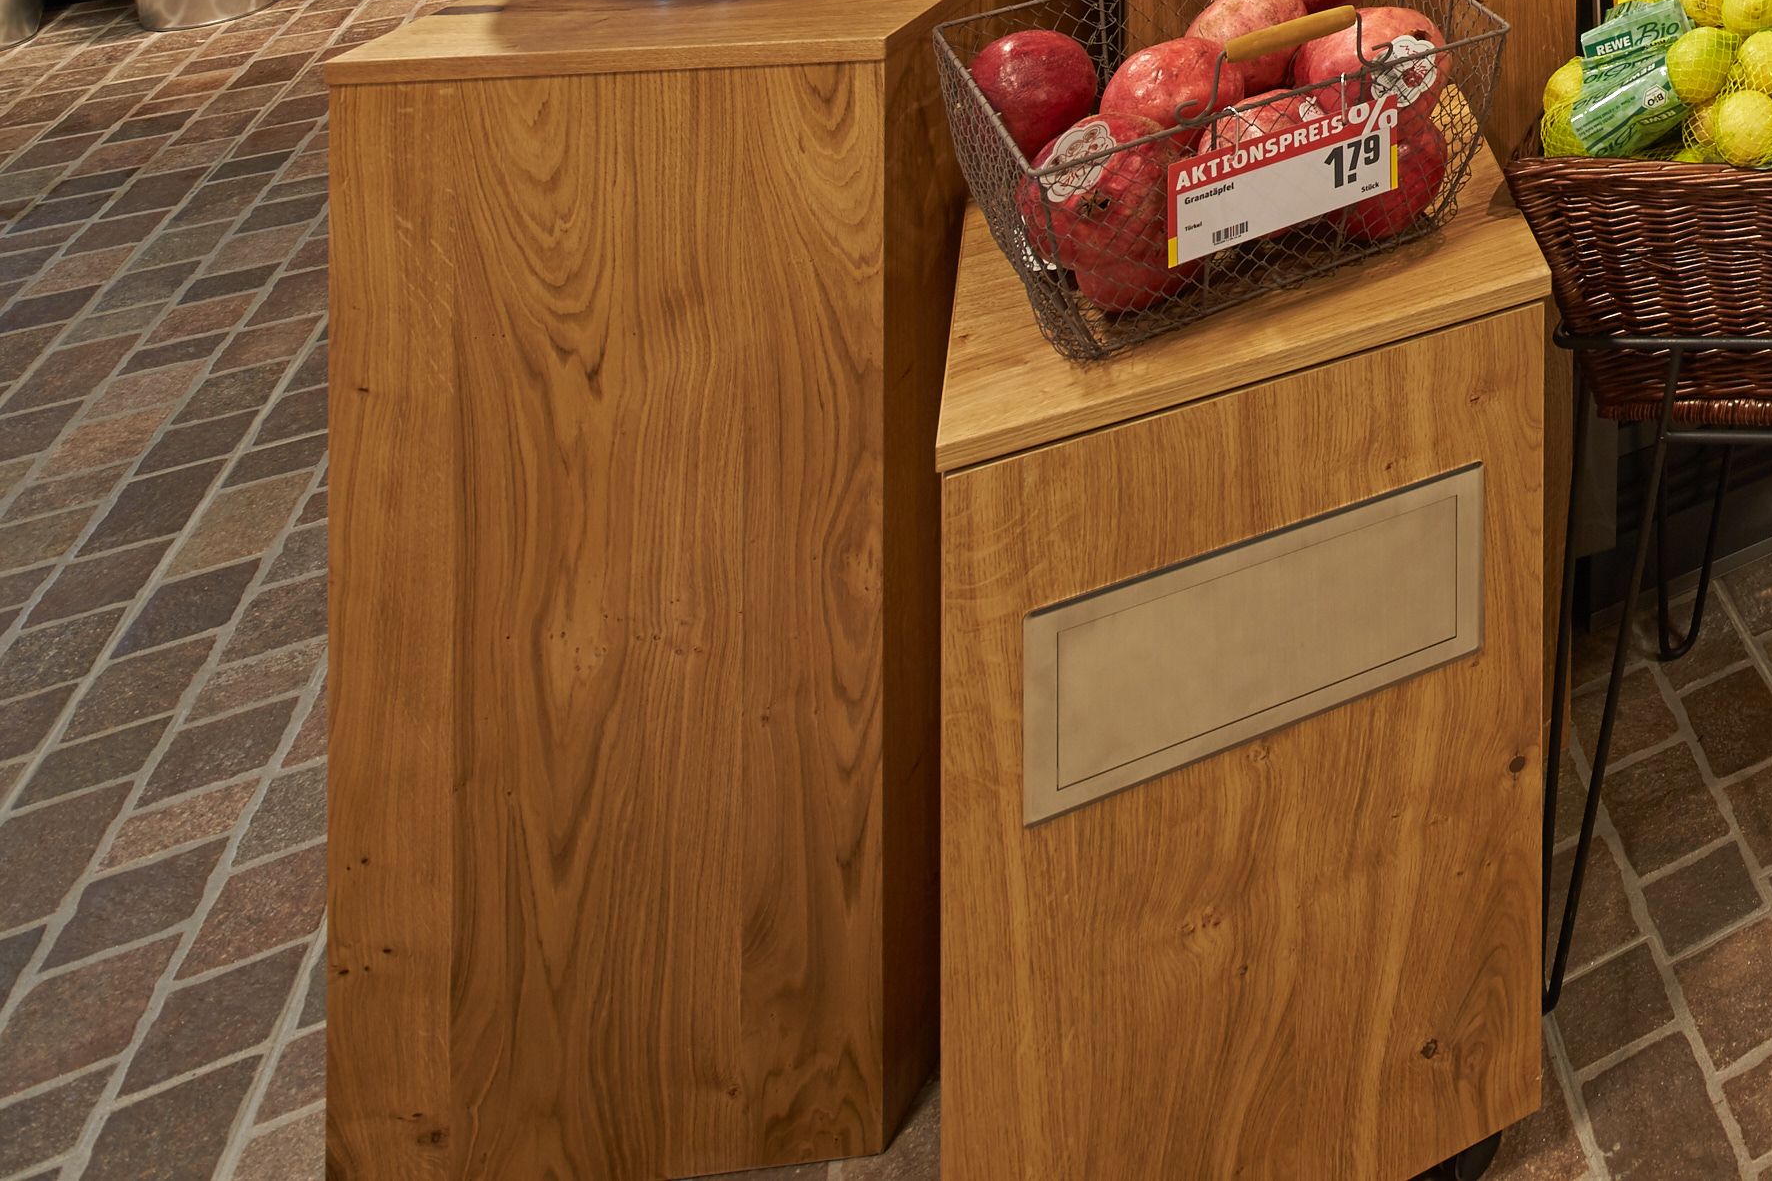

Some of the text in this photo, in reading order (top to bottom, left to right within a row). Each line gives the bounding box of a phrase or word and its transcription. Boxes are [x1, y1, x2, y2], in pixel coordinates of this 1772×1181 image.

[1596, 21, 1680, 56] REWE Bio
[1175, 114, 1344, 191] AKTIONSPREIS
[1324, 134, 1381, 189] 1.79
[1184, 182, 1235, 205] Granatäpfel
[1361, 181, 1380, 194] Stück
[1184, 221, 1203, 232] Türkei
